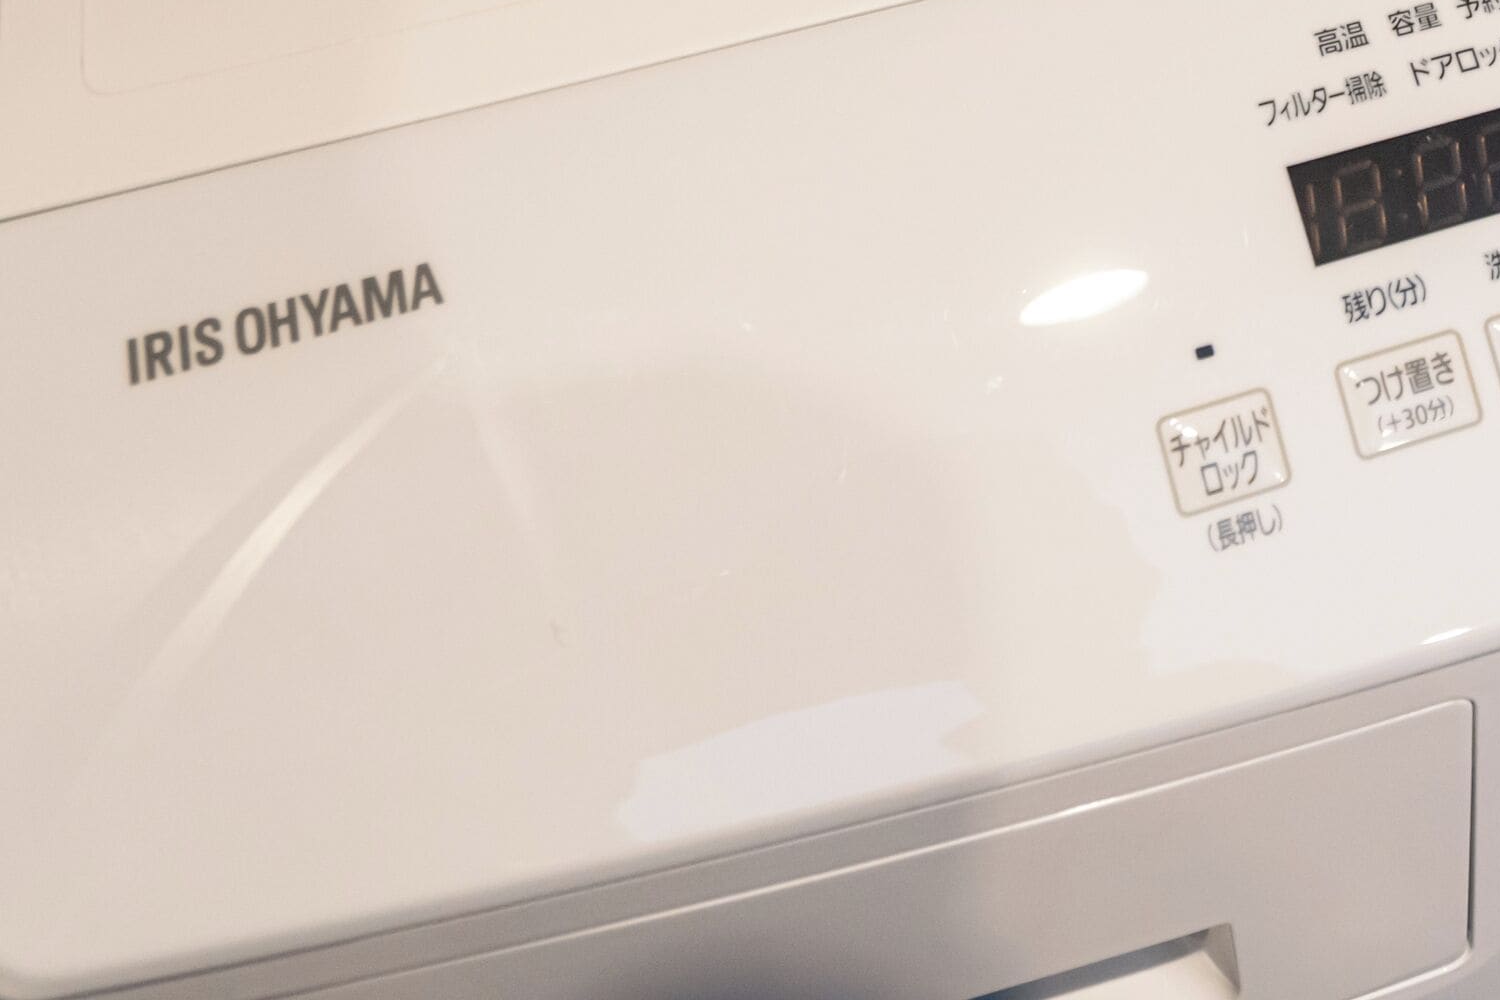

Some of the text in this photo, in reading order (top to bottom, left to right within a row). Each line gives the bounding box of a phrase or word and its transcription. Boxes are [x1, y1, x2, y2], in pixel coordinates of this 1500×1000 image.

[1314, 22, 1370, 57] 高温
[1387, 2, 1443, 38] 容量
[1258, 71, 1387, 127] フィルター掃除
[126, 262, 444, 387] IRIS OHYAMA
[1341, 274, 1428, 324] 残り(分)
[1356, 351, 1456, 407] つけ置き
[1169, 406, 1271, 466] チャイルド
[1378, 399, 1455, 434] (+30分)
[1200, 450, 1260, 497] ロック
[1207, 504, 1283, 553] (長押し)
